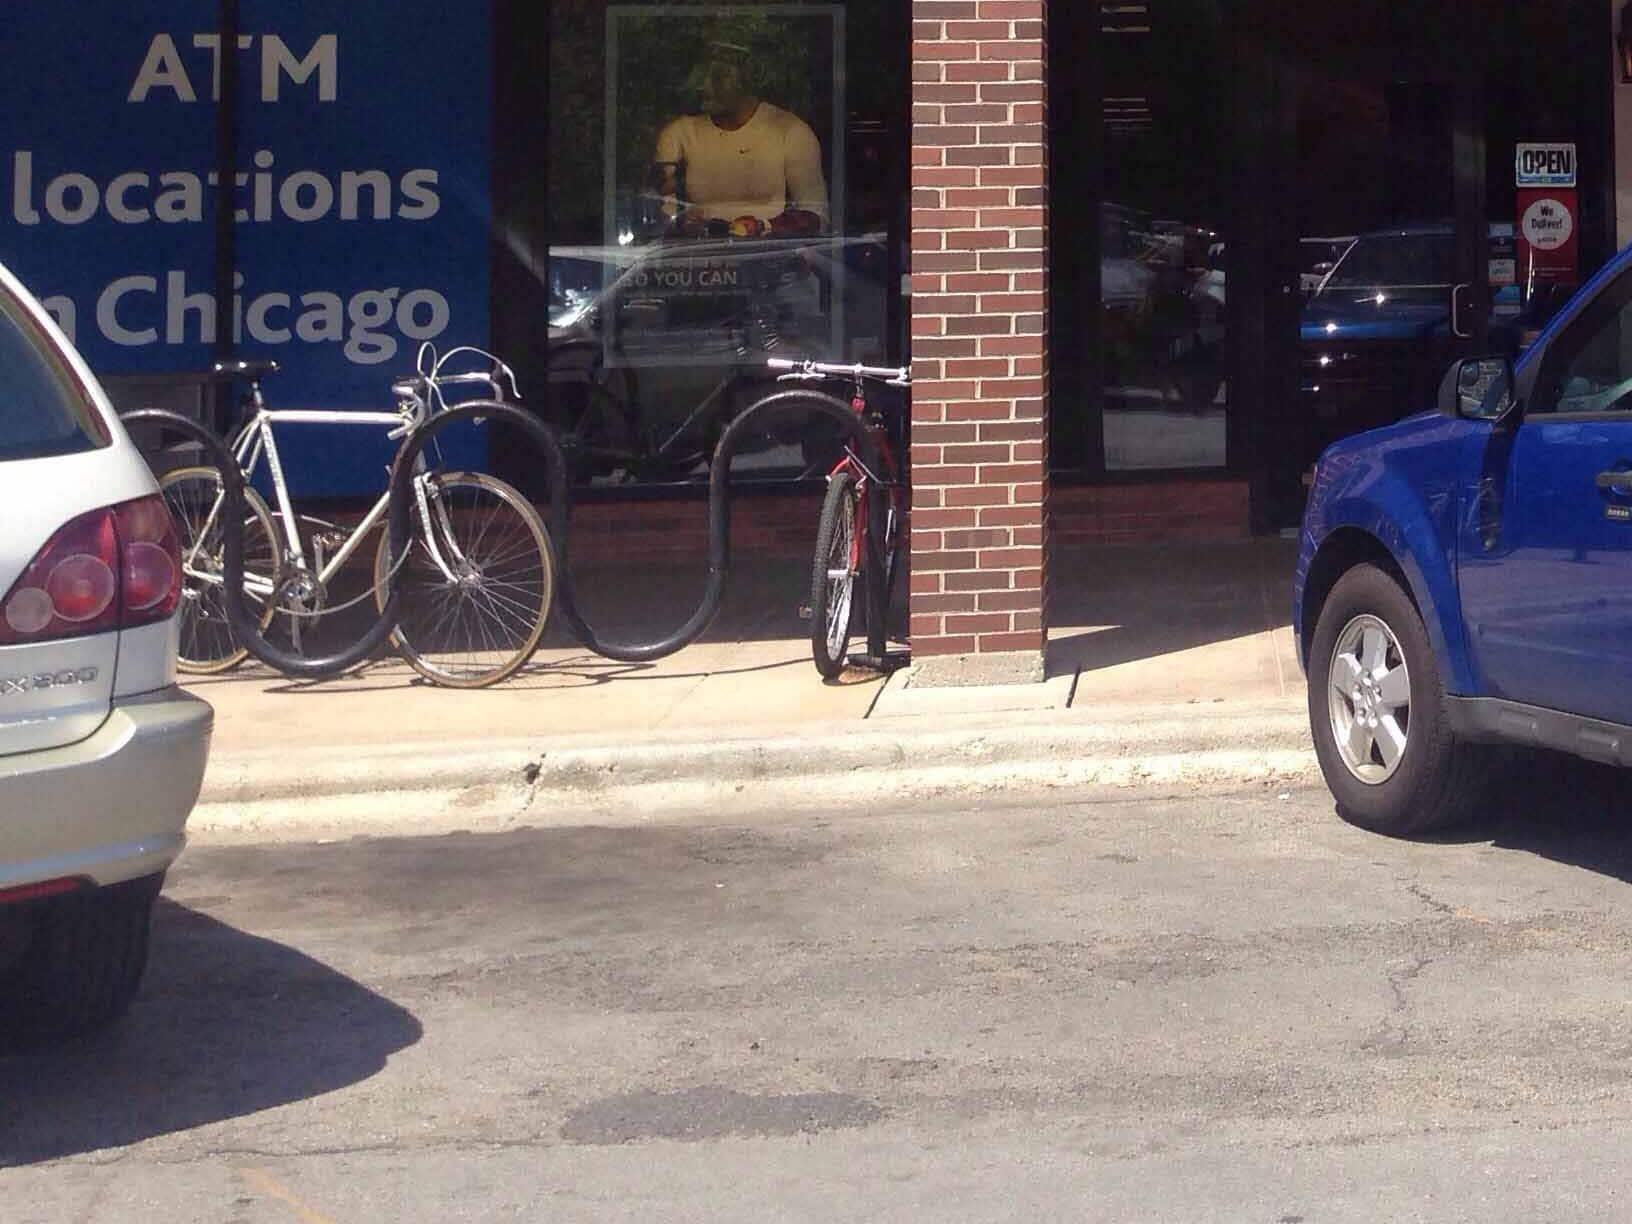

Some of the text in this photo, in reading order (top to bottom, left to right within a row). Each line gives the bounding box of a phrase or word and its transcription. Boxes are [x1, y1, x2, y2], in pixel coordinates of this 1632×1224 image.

[127, 32, 338, 103] ATM
[1522, 150, 1571, 175] OPEN
[654, 271, 693, 287] YOU
[699, 271, 737, 287] CAN
[95, 270, 451, 365] Chicago
